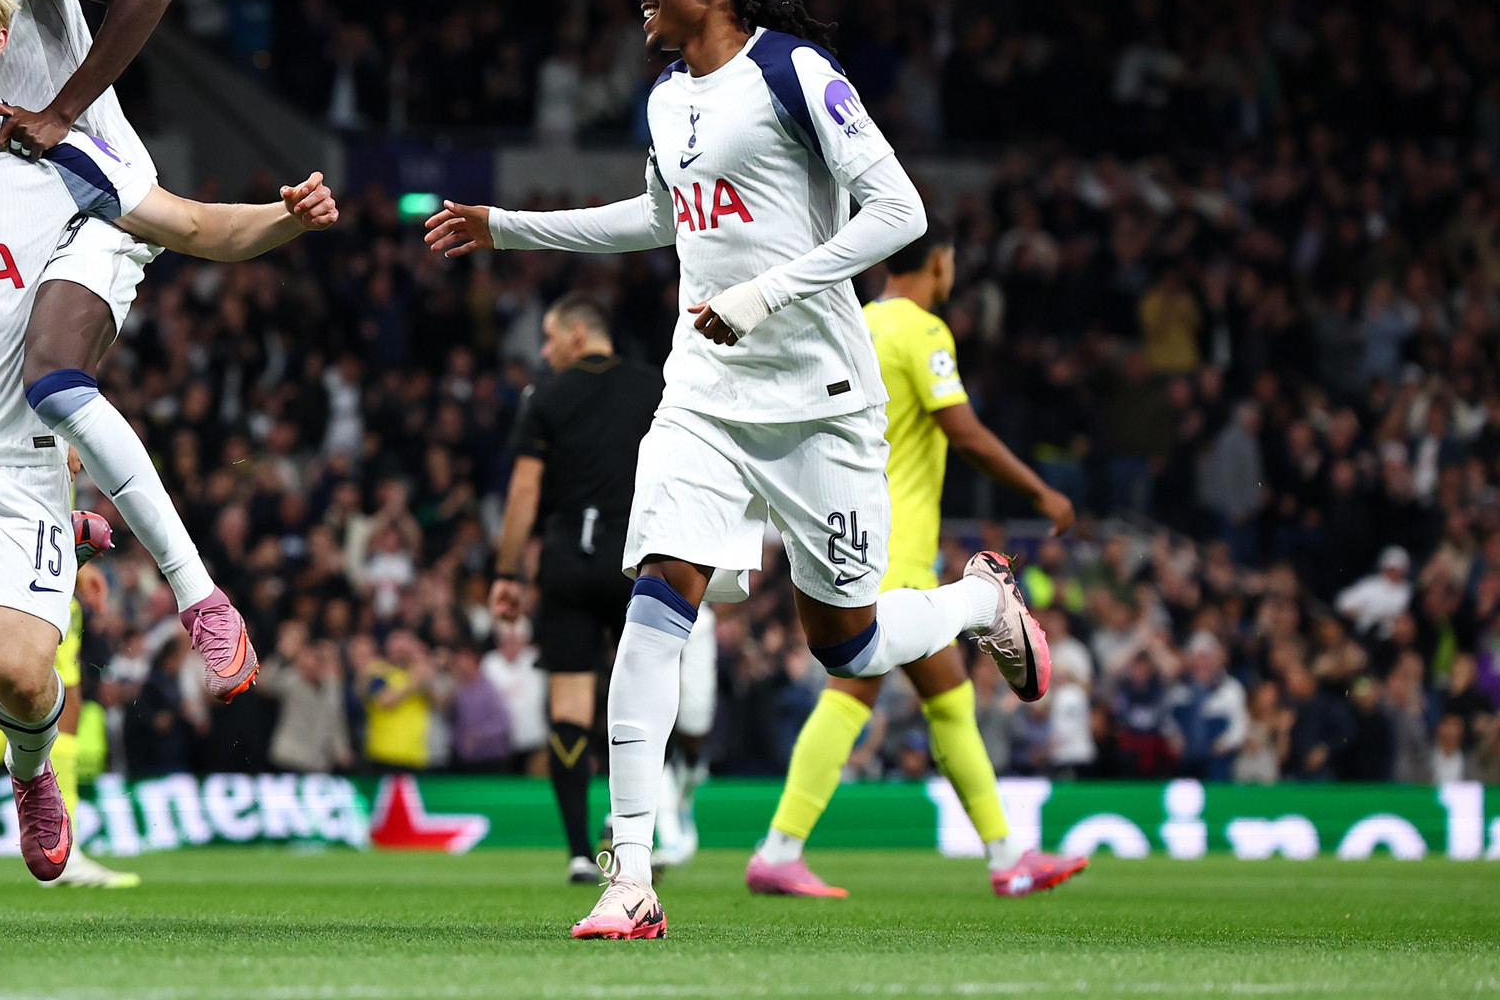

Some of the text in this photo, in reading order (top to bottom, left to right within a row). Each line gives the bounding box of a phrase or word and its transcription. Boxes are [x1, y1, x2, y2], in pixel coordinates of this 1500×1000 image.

[672, 178, 755, 233] AIA
[34, 519, 63, 577] 15
[827, 510, 869, 566] 24
